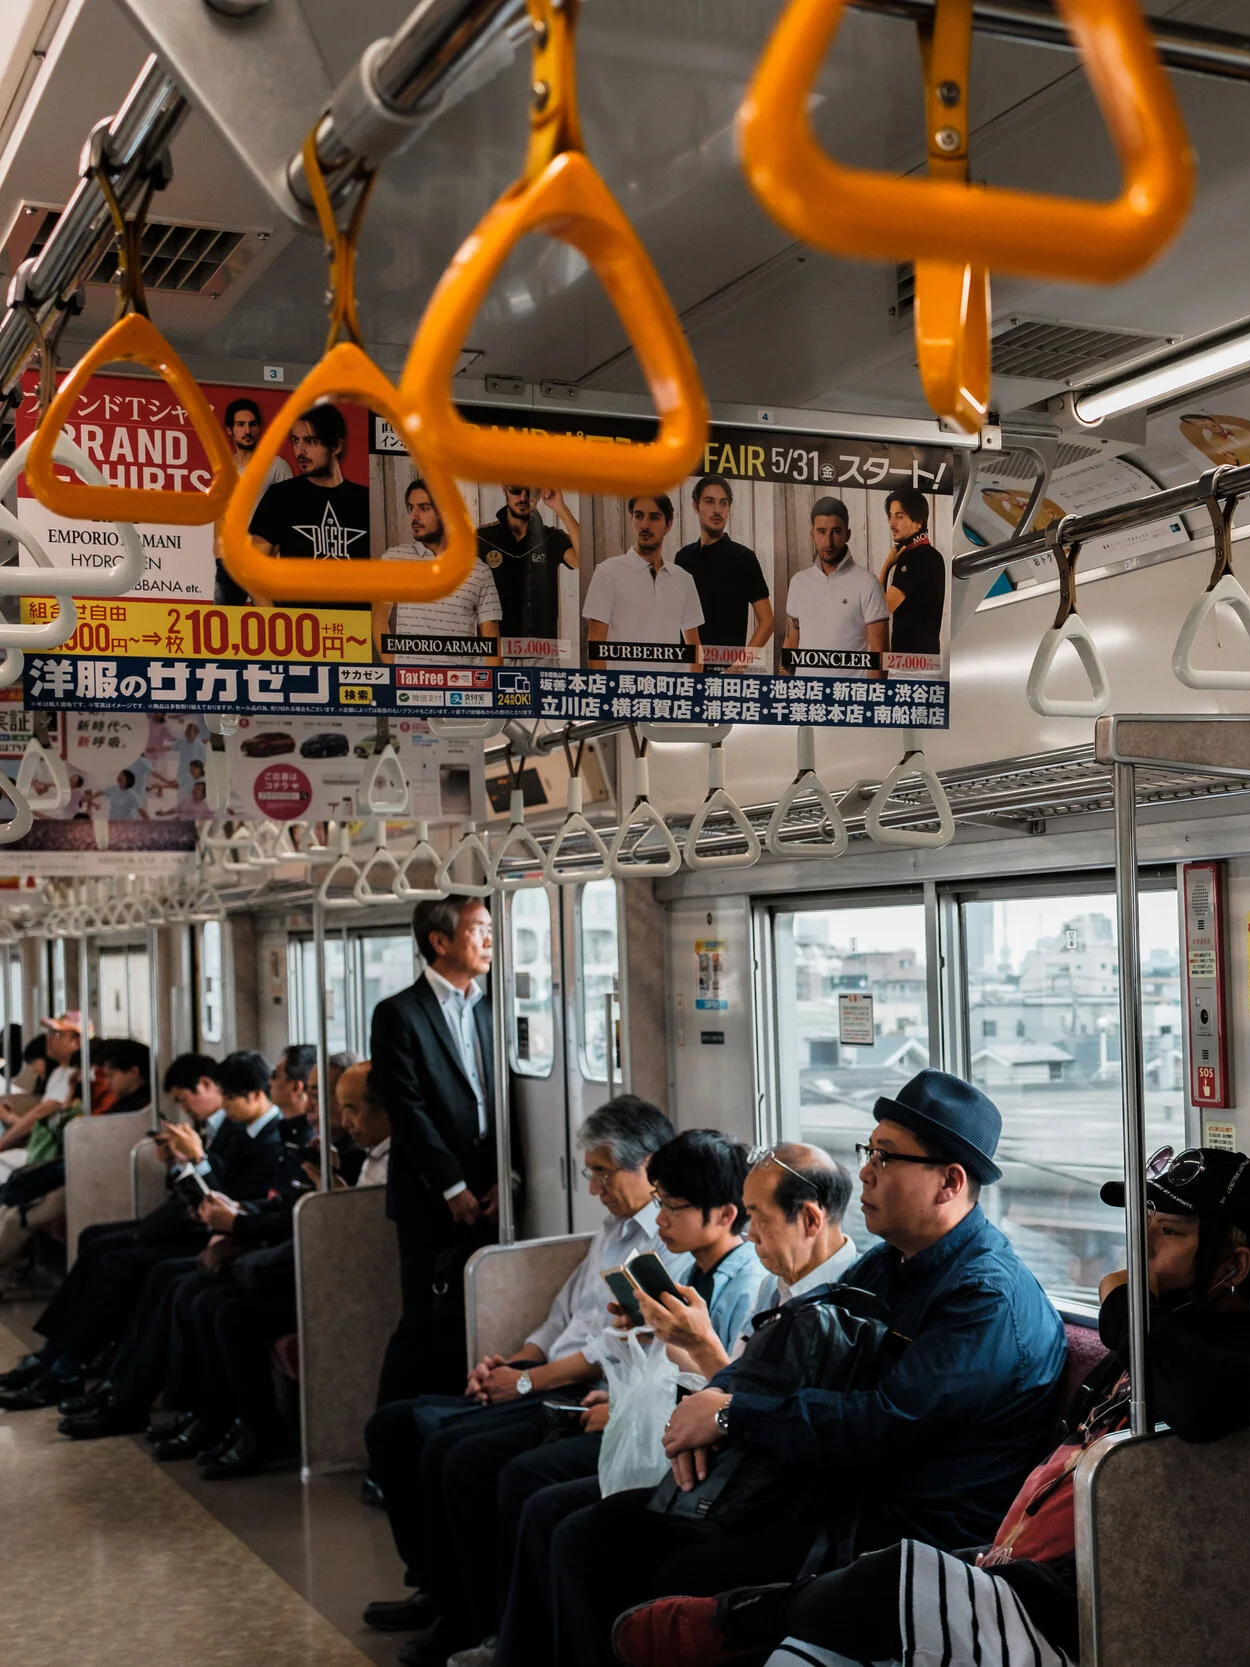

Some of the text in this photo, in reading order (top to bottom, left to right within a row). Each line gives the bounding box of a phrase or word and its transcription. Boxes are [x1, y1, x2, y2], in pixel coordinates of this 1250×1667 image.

[269, 369, 277, 379] 3
[762, 413, 770, 421] 4
[704, 442, 765, 478] FAIR
[771, 447, 819, 481] 5/31
[48, 529, 181, 549] EMPORIO MANI
[186, 585, 202, 594] etc.
[387, 639, 493, 654] EMPORIO ARMANI
[598, 645, 686, 660] BURBERRY
[790, 651, 872, 668] MONCLER
[29, 658, 331, 704] 洋服のサカゼン
[340, 668, 385, 682] サカゼン
[344, 689, 369, 702] 検索
[1200, 1068, 1213, 1077] SOS
